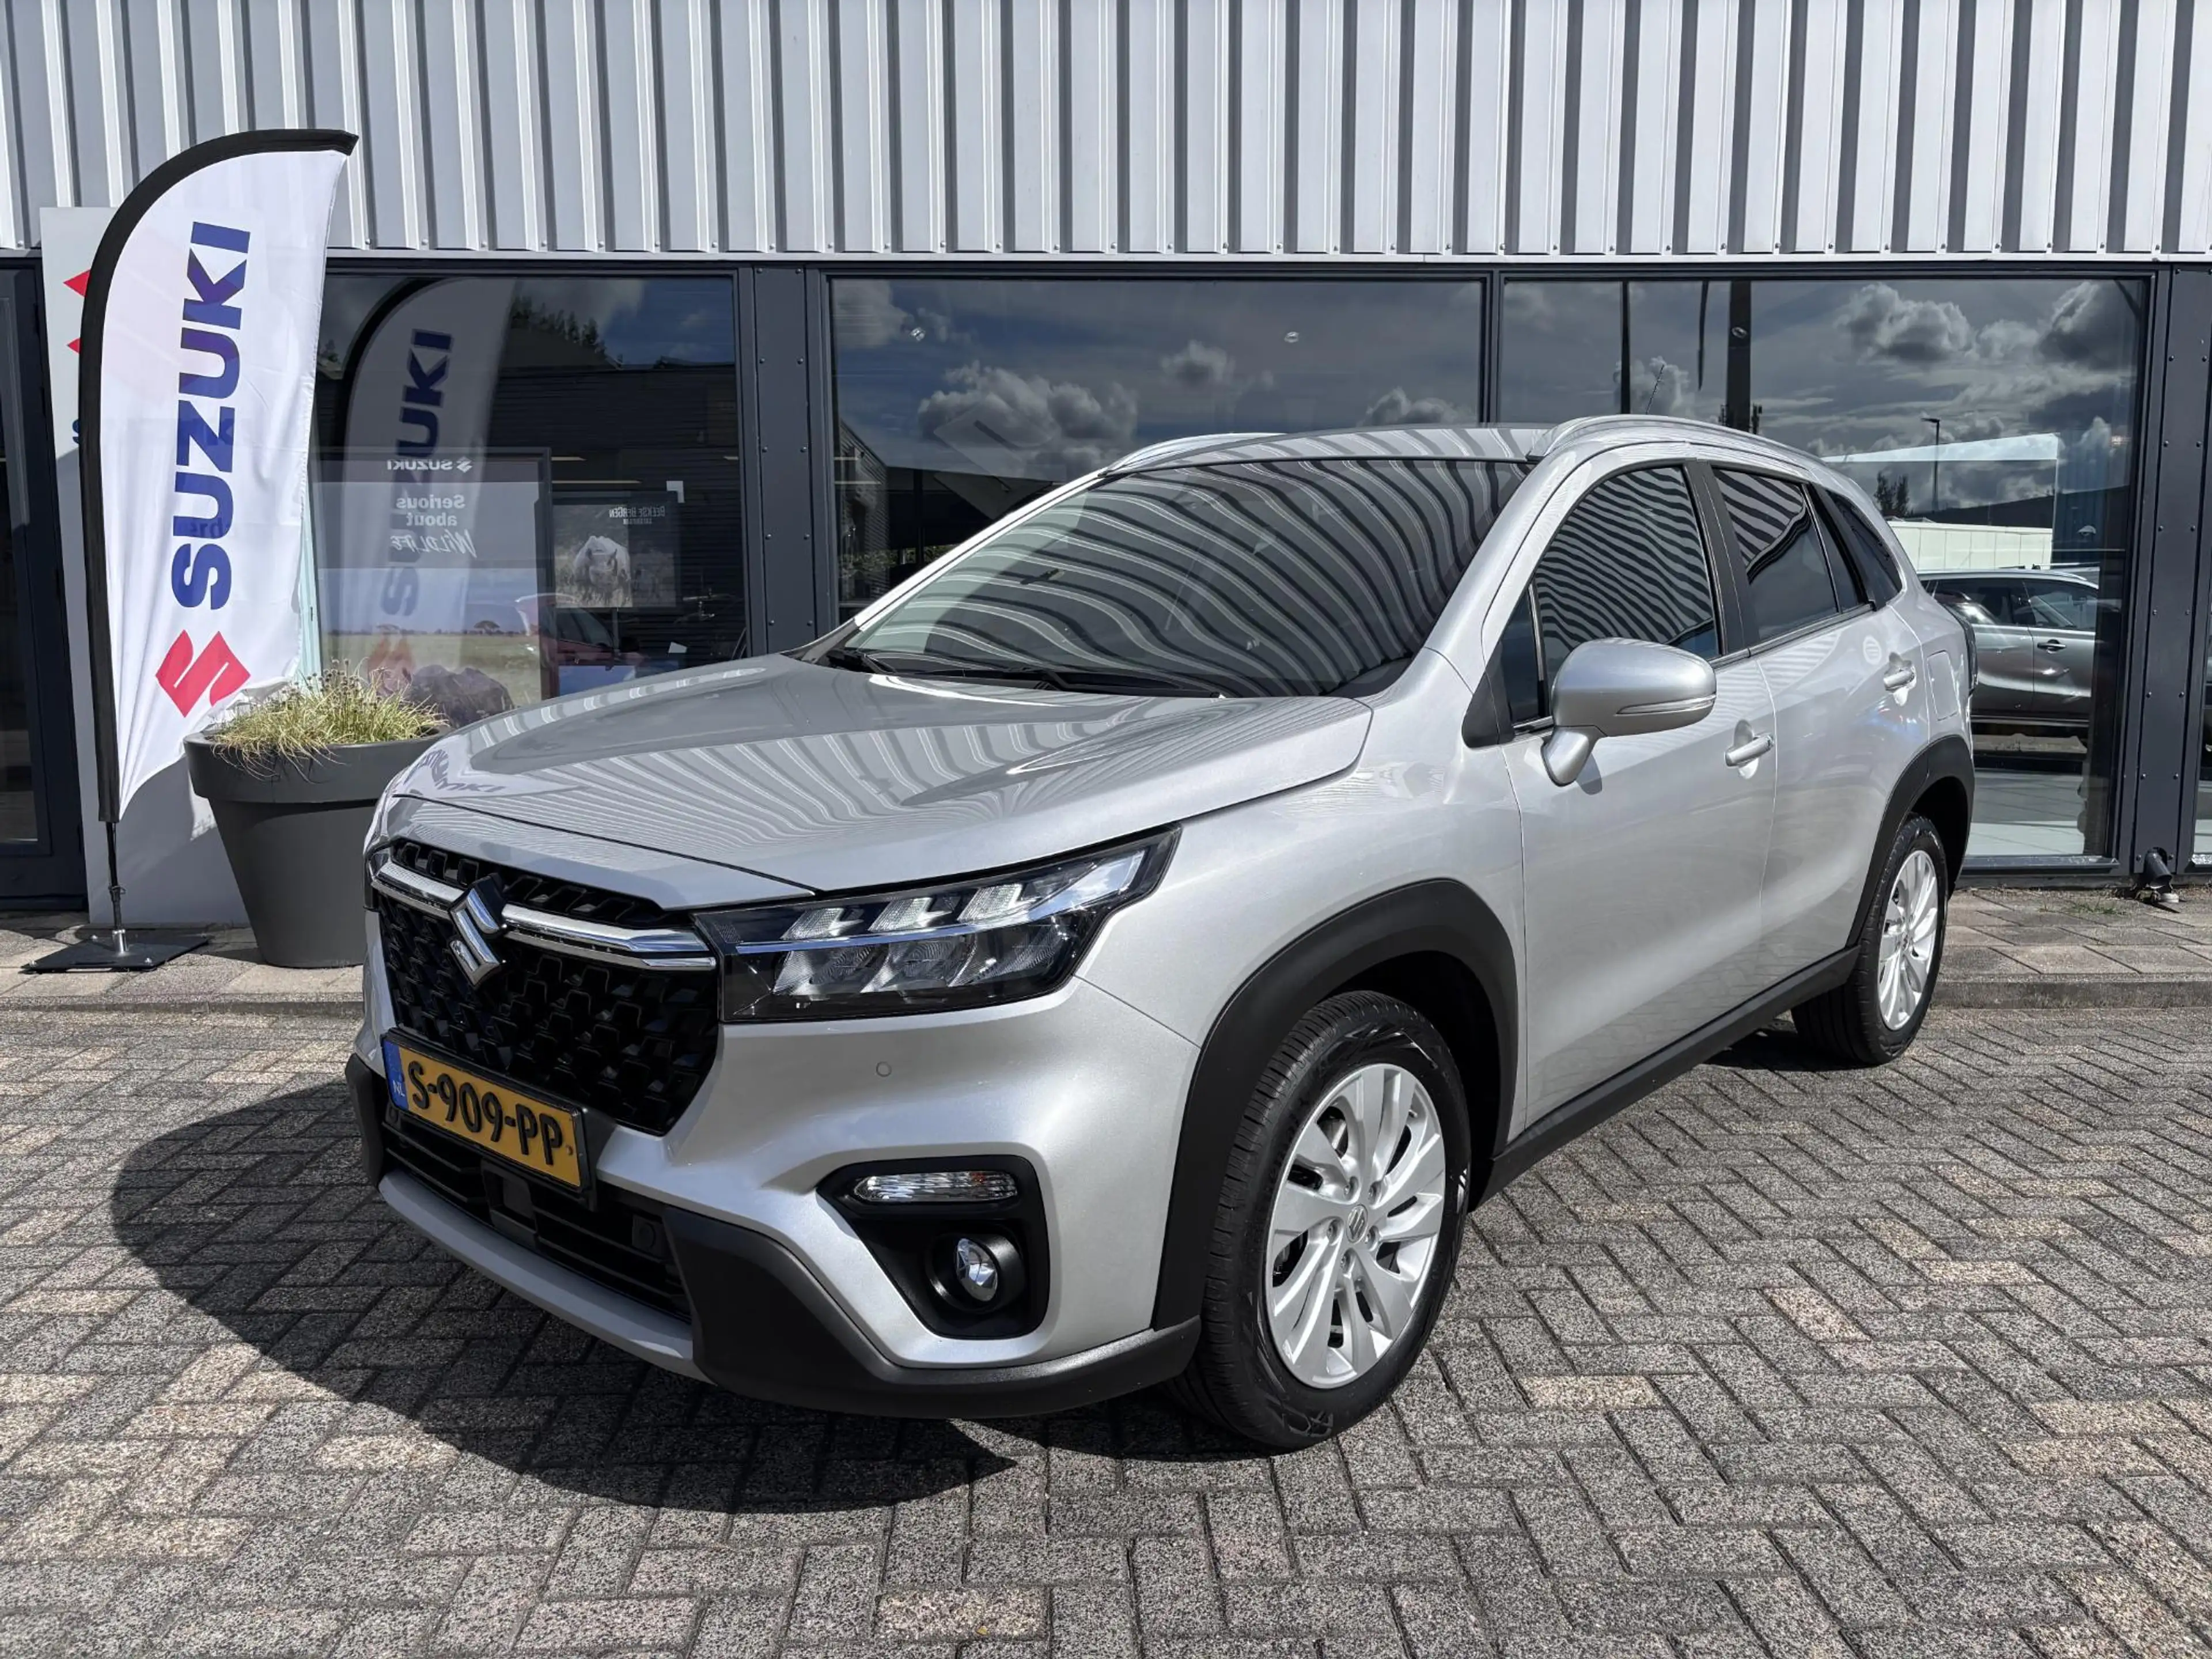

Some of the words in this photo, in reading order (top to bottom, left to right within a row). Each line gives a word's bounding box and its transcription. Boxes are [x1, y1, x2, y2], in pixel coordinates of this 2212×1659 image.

[172, 221, 251, 610] SUZUKI
[380, 328, 454, 616] SUZUKI
[393, 1080, 406, 1096] NL
[408, 1060, 563, 1165] S-909-PP
